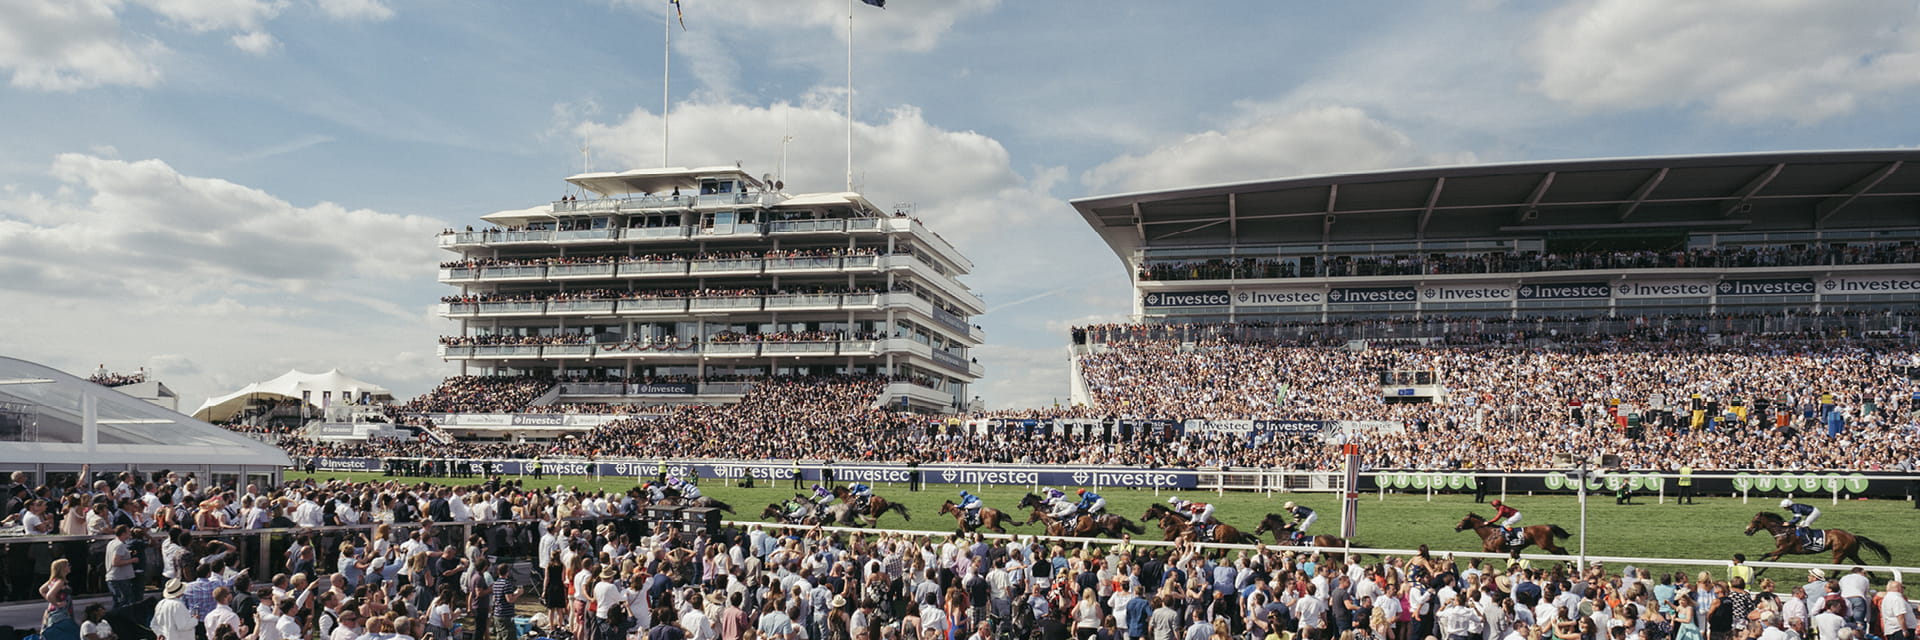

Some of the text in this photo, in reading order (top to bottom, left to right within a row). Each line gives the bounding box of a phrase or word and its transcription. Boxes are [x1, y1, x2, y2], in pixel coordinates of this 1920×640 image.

[1535, 285, 1609, 297] Investec
[1634, 283, 1709, 295] Investec
[1735, 281, 1813, 294] Investec
[1840, 279, 1920, 291] Investec
[1161, 293, 1229, 305] Investec
[1252, 291, 1321, 303] Investec
[1345, 289, 1415, 301] Investec
[1439, 287, 1511, 299] Investec
[648, 385, 686, 393] Investec
[522, 416, 562, 425] Investec
[1199, 421, 1249, 430] Investec
[1266, 421, 1318, 431] Investec
[328, 458, 366, 468] Investec
[838, 469, 910, 481] Investec
[960, 470, 1037, 484] Investec
[1092, 472, 1177, 486] Investec
[1738, 477, 1861, 489] UNIBET
